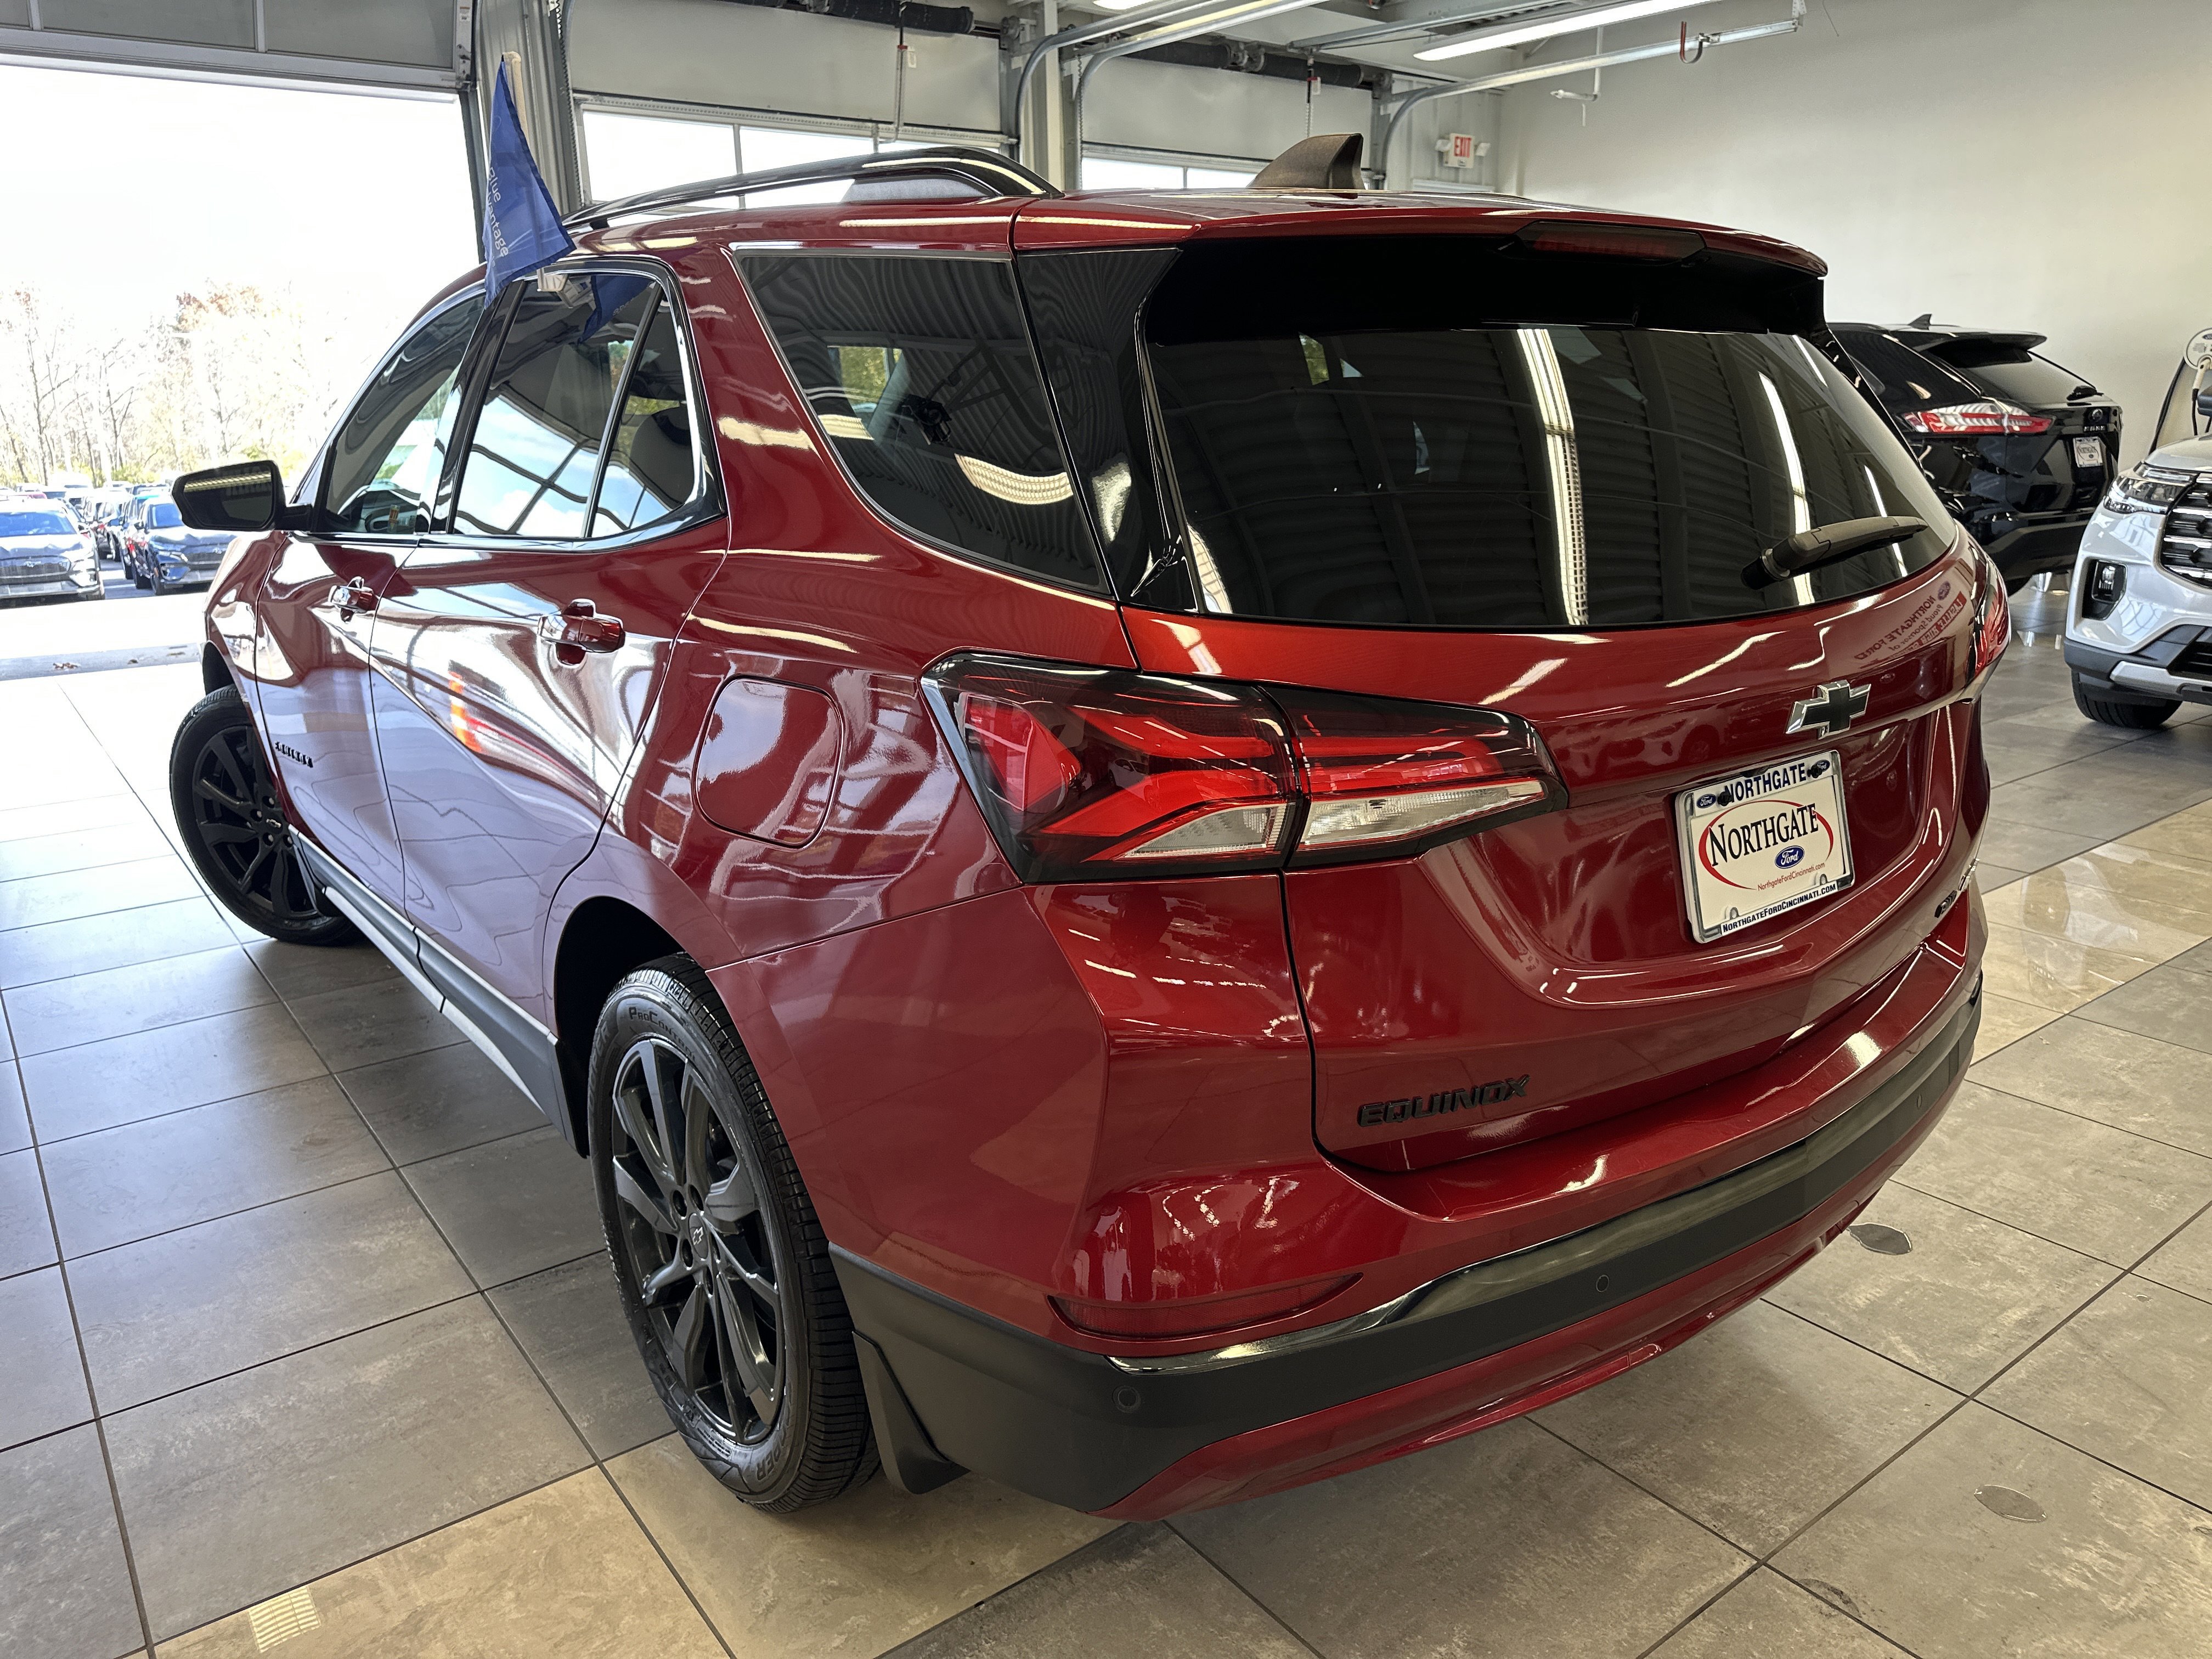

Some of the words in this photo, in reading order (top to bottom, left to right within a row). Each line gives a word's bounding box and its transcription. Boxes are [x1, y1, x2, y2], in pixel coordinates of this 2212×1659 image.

[1454, 137, 1472, 158] EXIT
[488, 167, 501, 203] Blue
[1724, 763, 1807, 803] NORTHGATE
[1709, 803, 1819, 867] NORTHGATE
[1757, 862, 1825, 891] NorthgateFordCincinnati.com
[1357, 1074, 1531, 1127] EQUINOX
